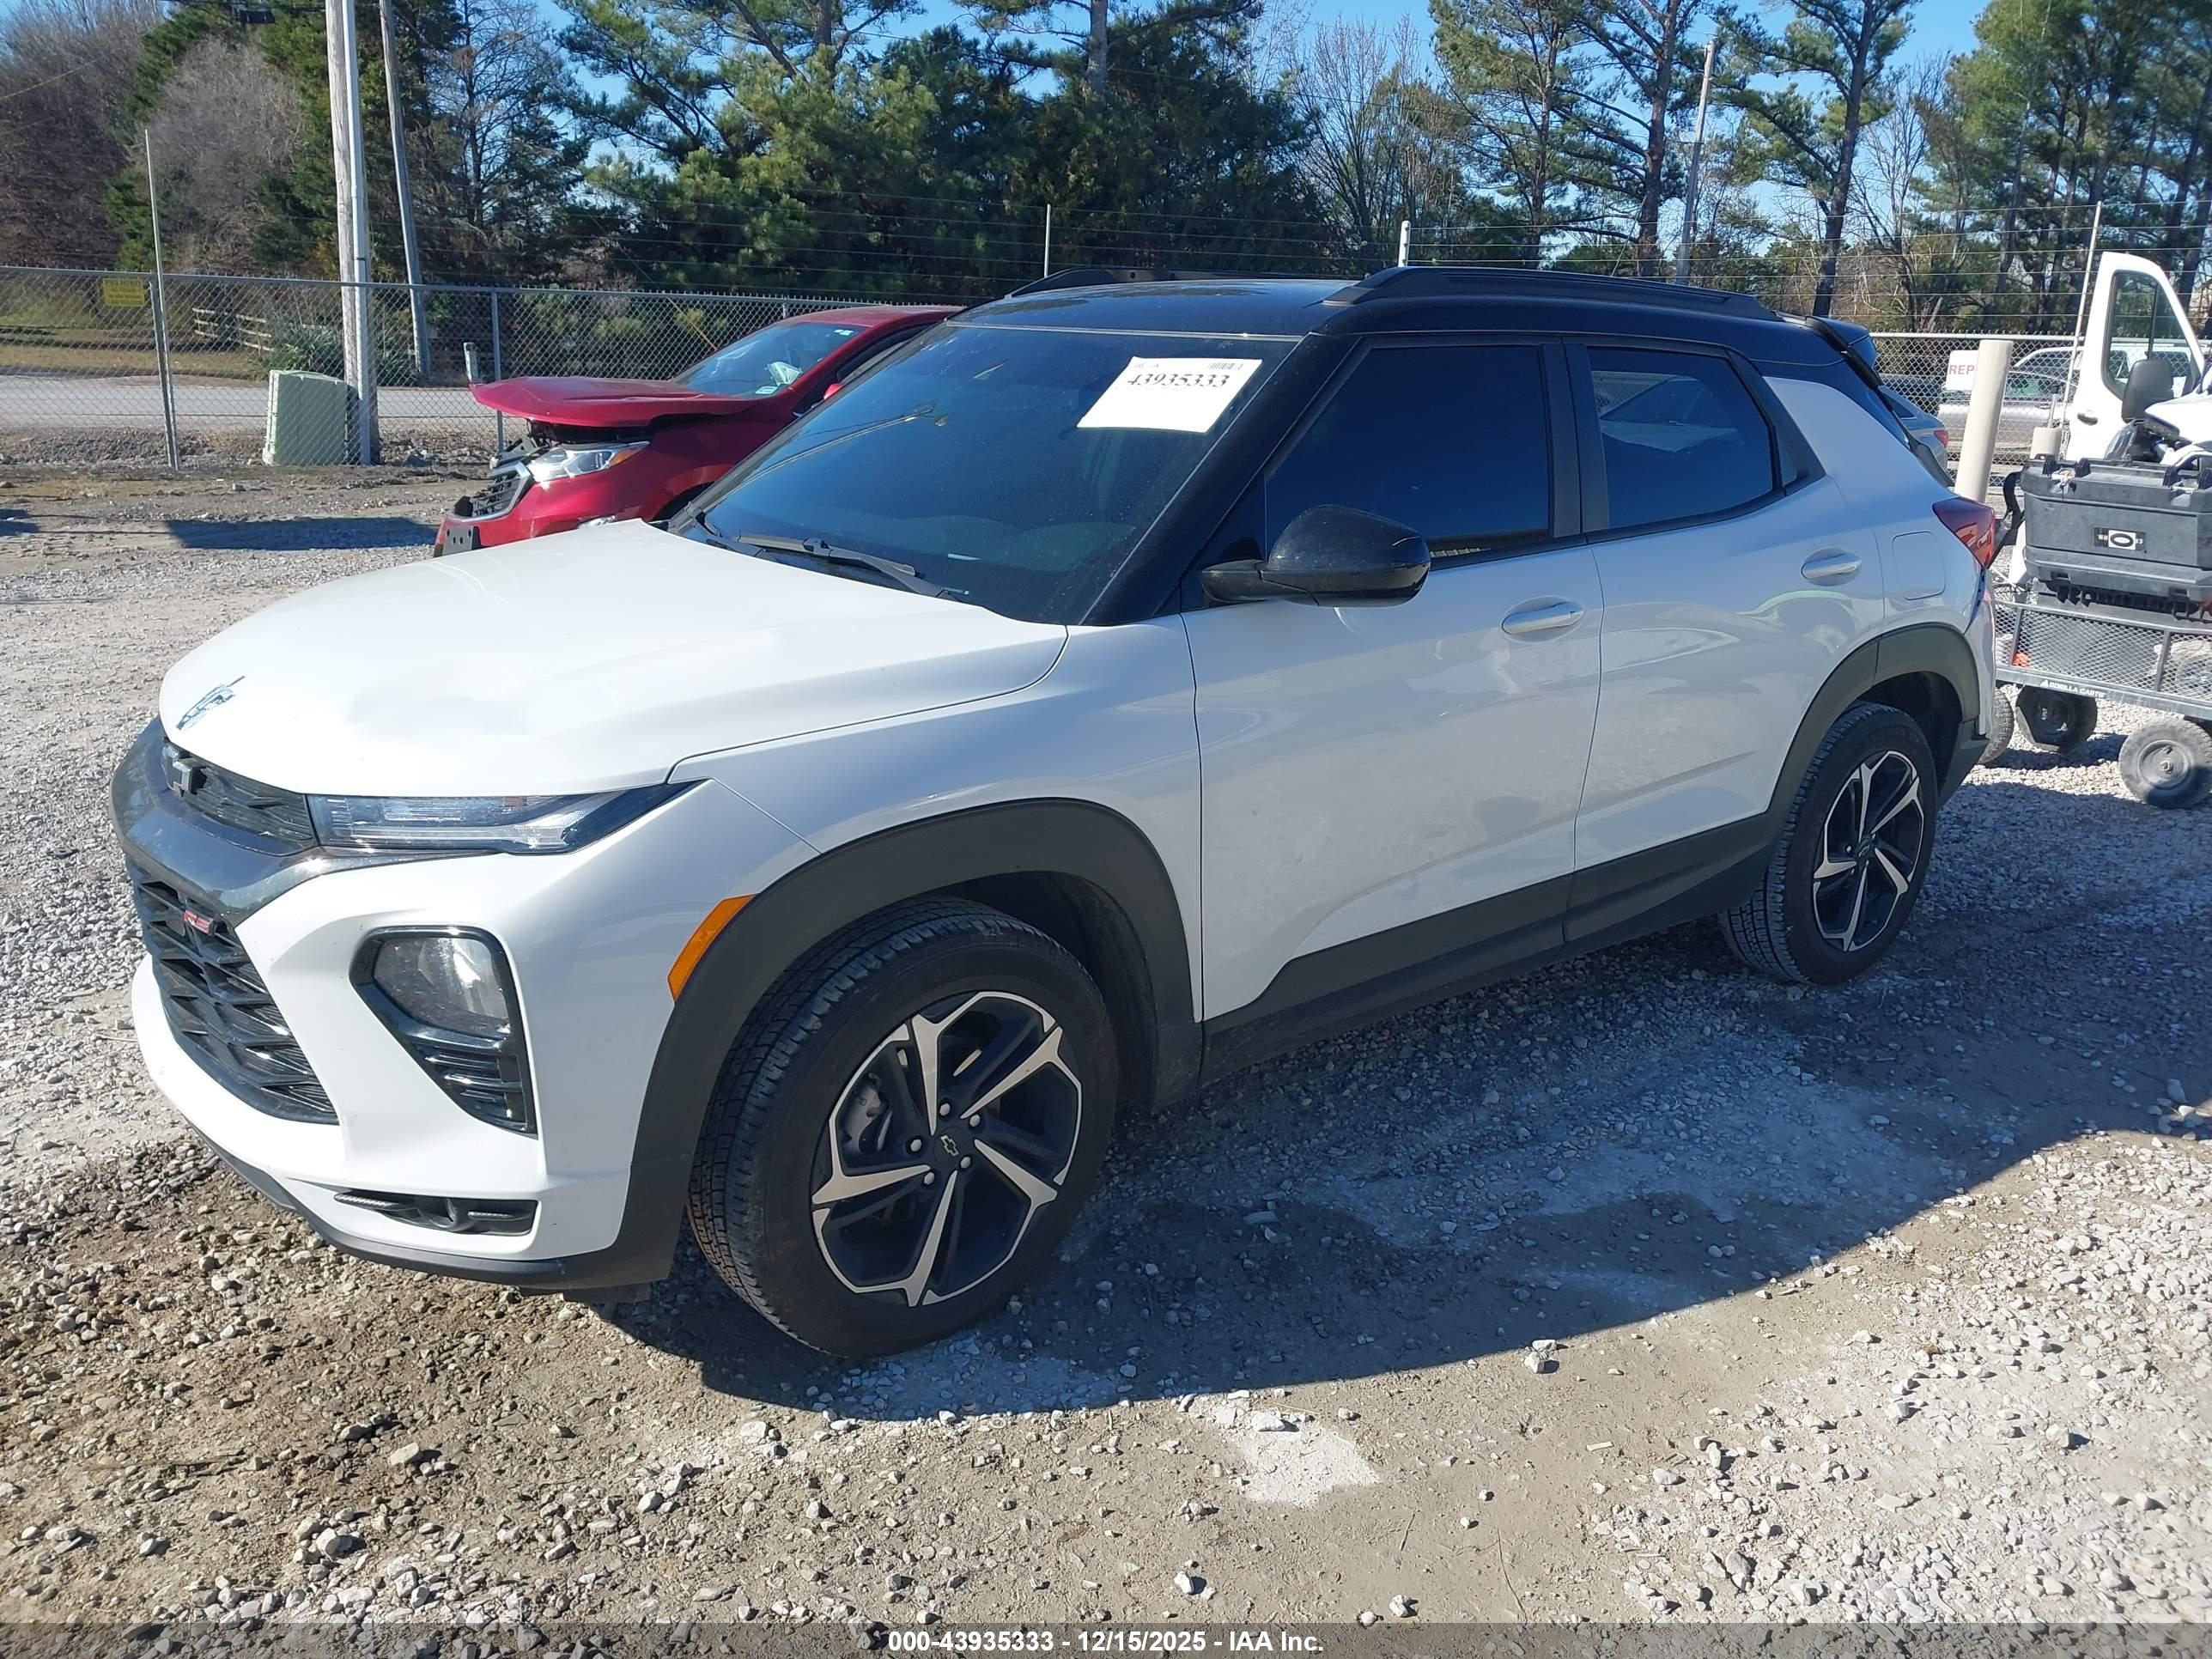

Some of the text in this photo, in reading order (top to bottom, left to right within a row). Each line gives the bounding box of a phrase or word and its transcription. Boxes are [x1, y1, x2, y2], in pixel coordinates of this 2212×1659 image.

[1948, 365, 1978, 374] REP
[1127, 374, 1230, 387] 43935333
[2049, 682, 2106, 697] GORILLA CARTS
